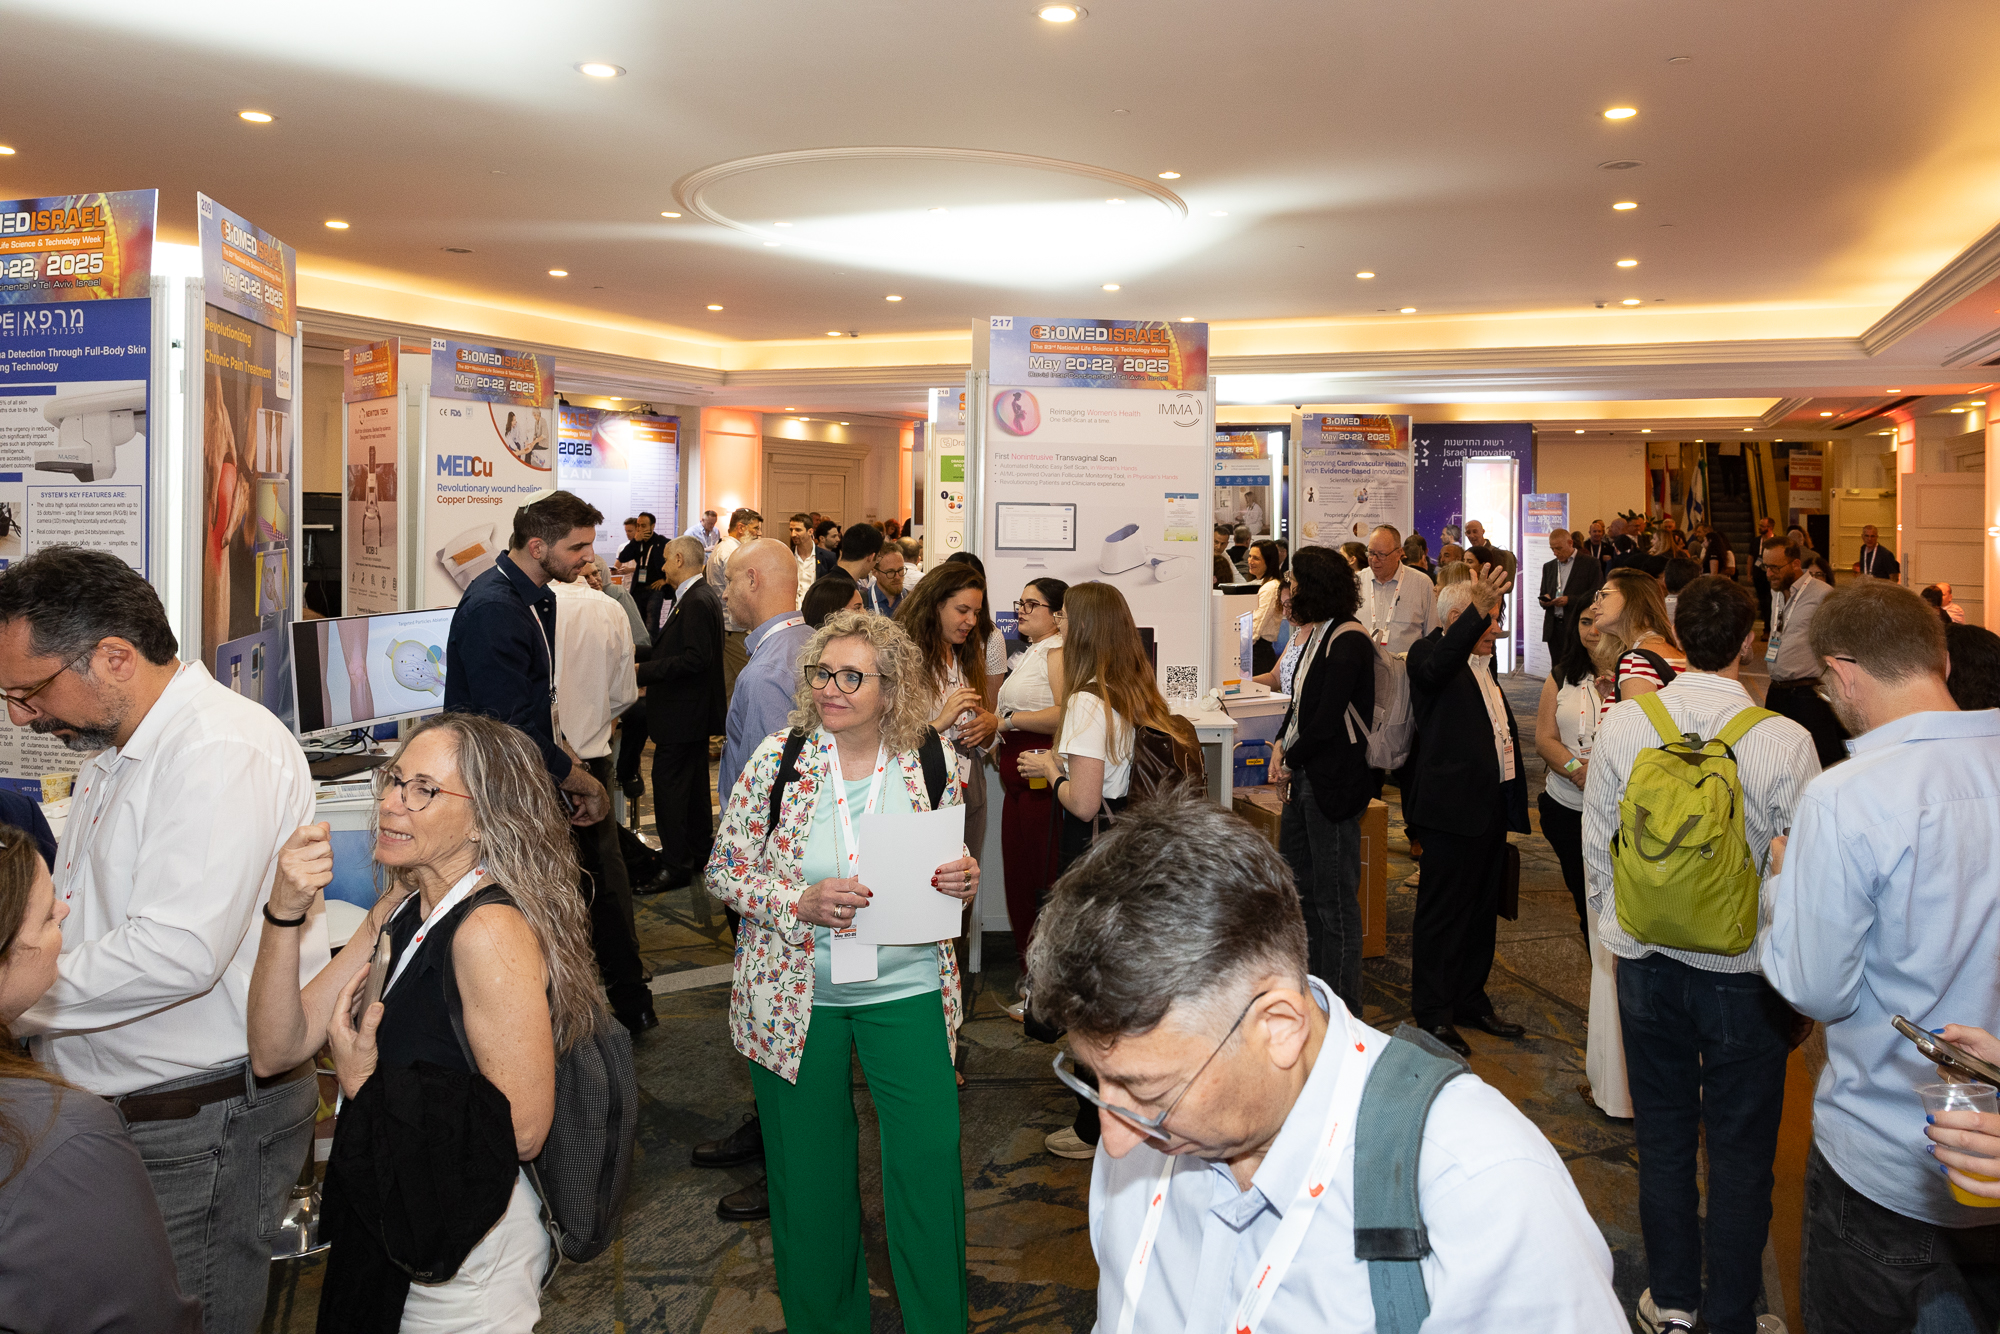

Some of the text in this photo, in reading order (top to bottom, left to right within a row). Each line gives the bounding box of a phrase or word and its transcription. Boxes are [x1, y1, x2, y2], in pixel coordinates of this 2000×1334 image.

[201, 199, 211, 214] 209
[0, 207, 105, 234] EDISRAEL
[45, 237, 80, 247] Technology
[82, 235, 101, 243] Week
[46, 253, 104, 276] 2025
[39, 281, 50, 289] Tel
[53, 280, 72, 289] Aviv,
[76, 278, 101, 287] Israel
[222, 265, 238, 292] May
[265, 284, 283, 309] 2025
[23, 309, 84, 329] מרפא
[992, 319, 1011, 328] 217
[205, 317, 251, 347] Revolutionizing
[8, 345, 147, 359] Detection Through Full-Body Skin
[0, 361, 59, 374] ng Technology
[205, 349, 271, 379] Chronic Pain Treatment
[1029, 356, 1060, 372] May
[1123, 358, 1169, 373] 2025
[455, 374, 474, 388] May
[509, 380, 535, 394] 2025
[451, 409, 461, 417] FDA
[1050, 407, 1141, 417] Reimaging Women's Health
[1158, 404, 1193, 416] IMMA
[560, 411, 592, 427] RAEL
[1321, 433, 1336, 441] May
[1367, 433, 1390, 441] 2025
[559, 442, 592, 456] 2025
[1443, 448, 1516, 457] Israel Innovation
[1011, 453, 1053, 461] Nonintrusive
[1055, 453, 1098, 463] Transvaginal
[1099, 454, 1117, 462] Scan
[1442, 458, 1463, 467] Auth
[437, 454, 493, 477] MEDCu
[560, 468, 592, 479] LAN
[437, 483, 489, 494] Revolutionary
[491, 484, 515, 493] wound
[437, 495, 502, 505] Copper Dressings
[1000, 625, 1012, 633] IVF
